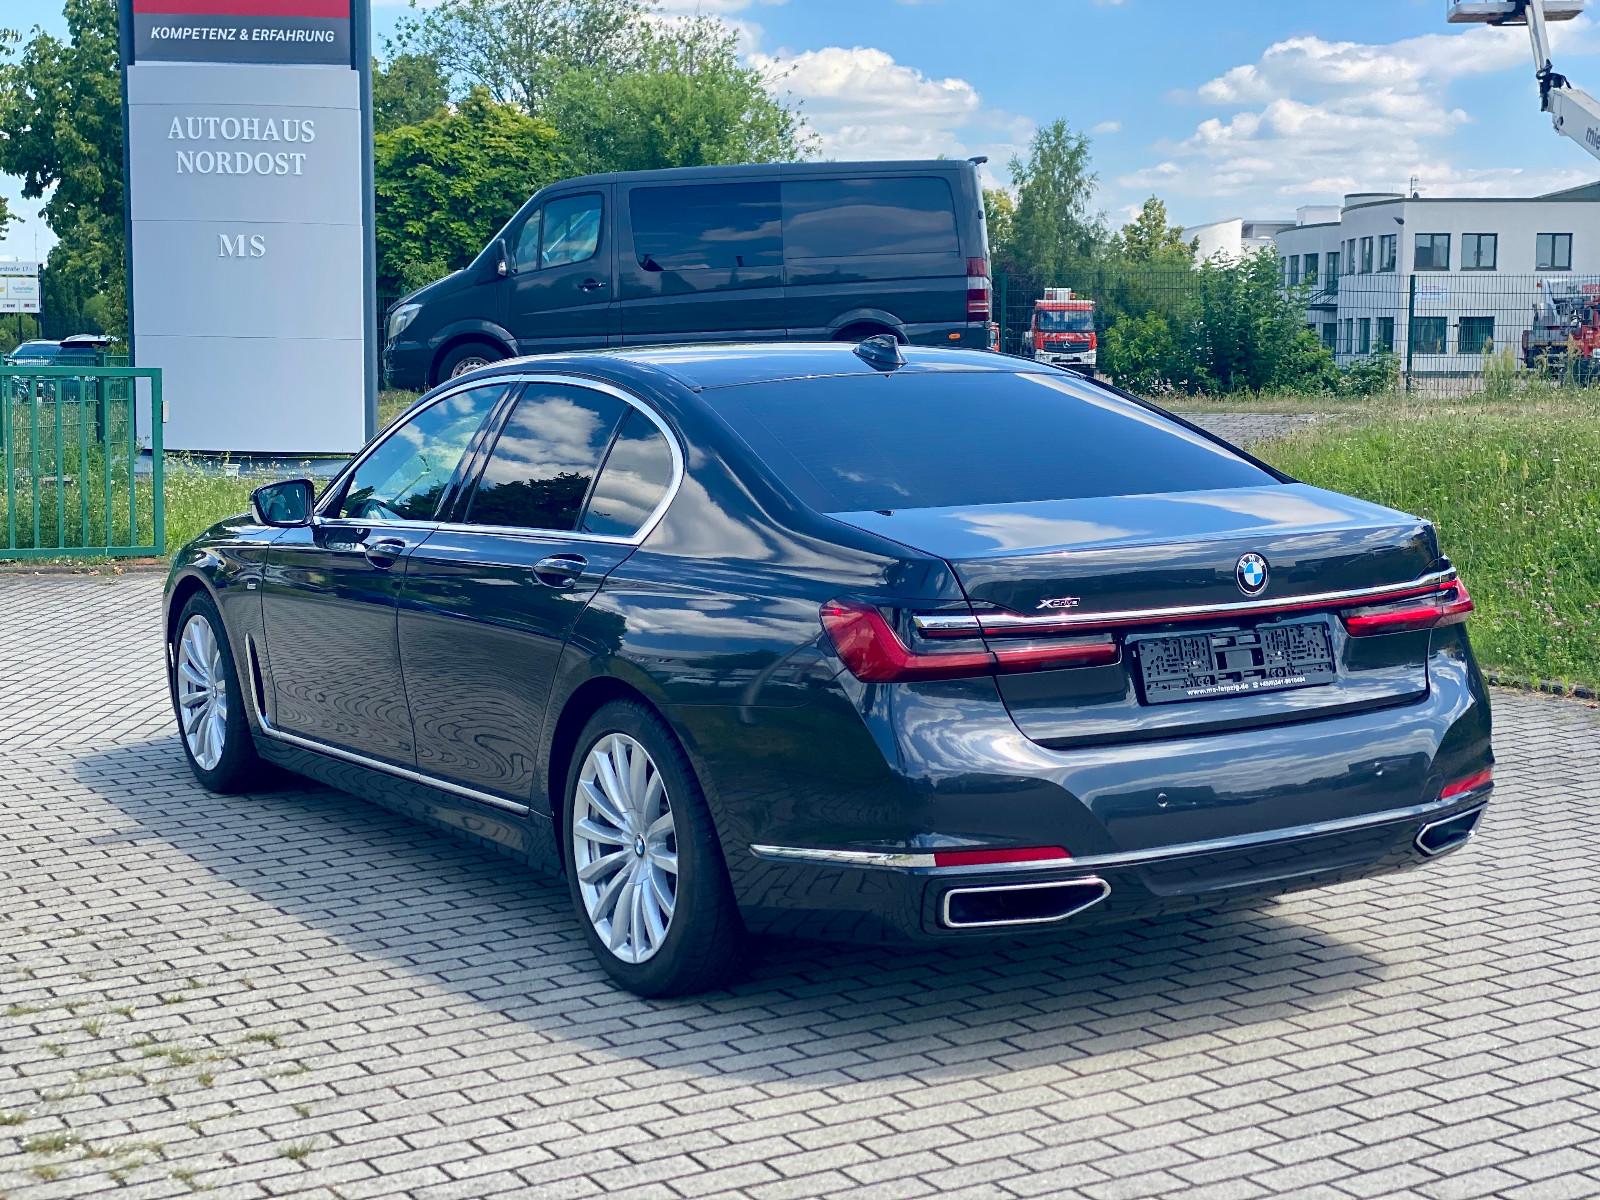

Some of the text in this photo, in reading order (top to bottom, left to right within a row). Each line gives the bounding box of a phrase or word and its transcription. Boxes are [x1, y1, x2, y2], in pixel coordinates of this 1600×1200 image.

[151, 27, 335, 43] KOMPETENZ & ERFAHRUNG
[168, 116, 316, 143] AUTOHAUS
[176, 151, 307, 175] NORDOST
[218, 233, 266, 258] MS
[1187, 682, 1249, 695] www.ms-leipzig.de
